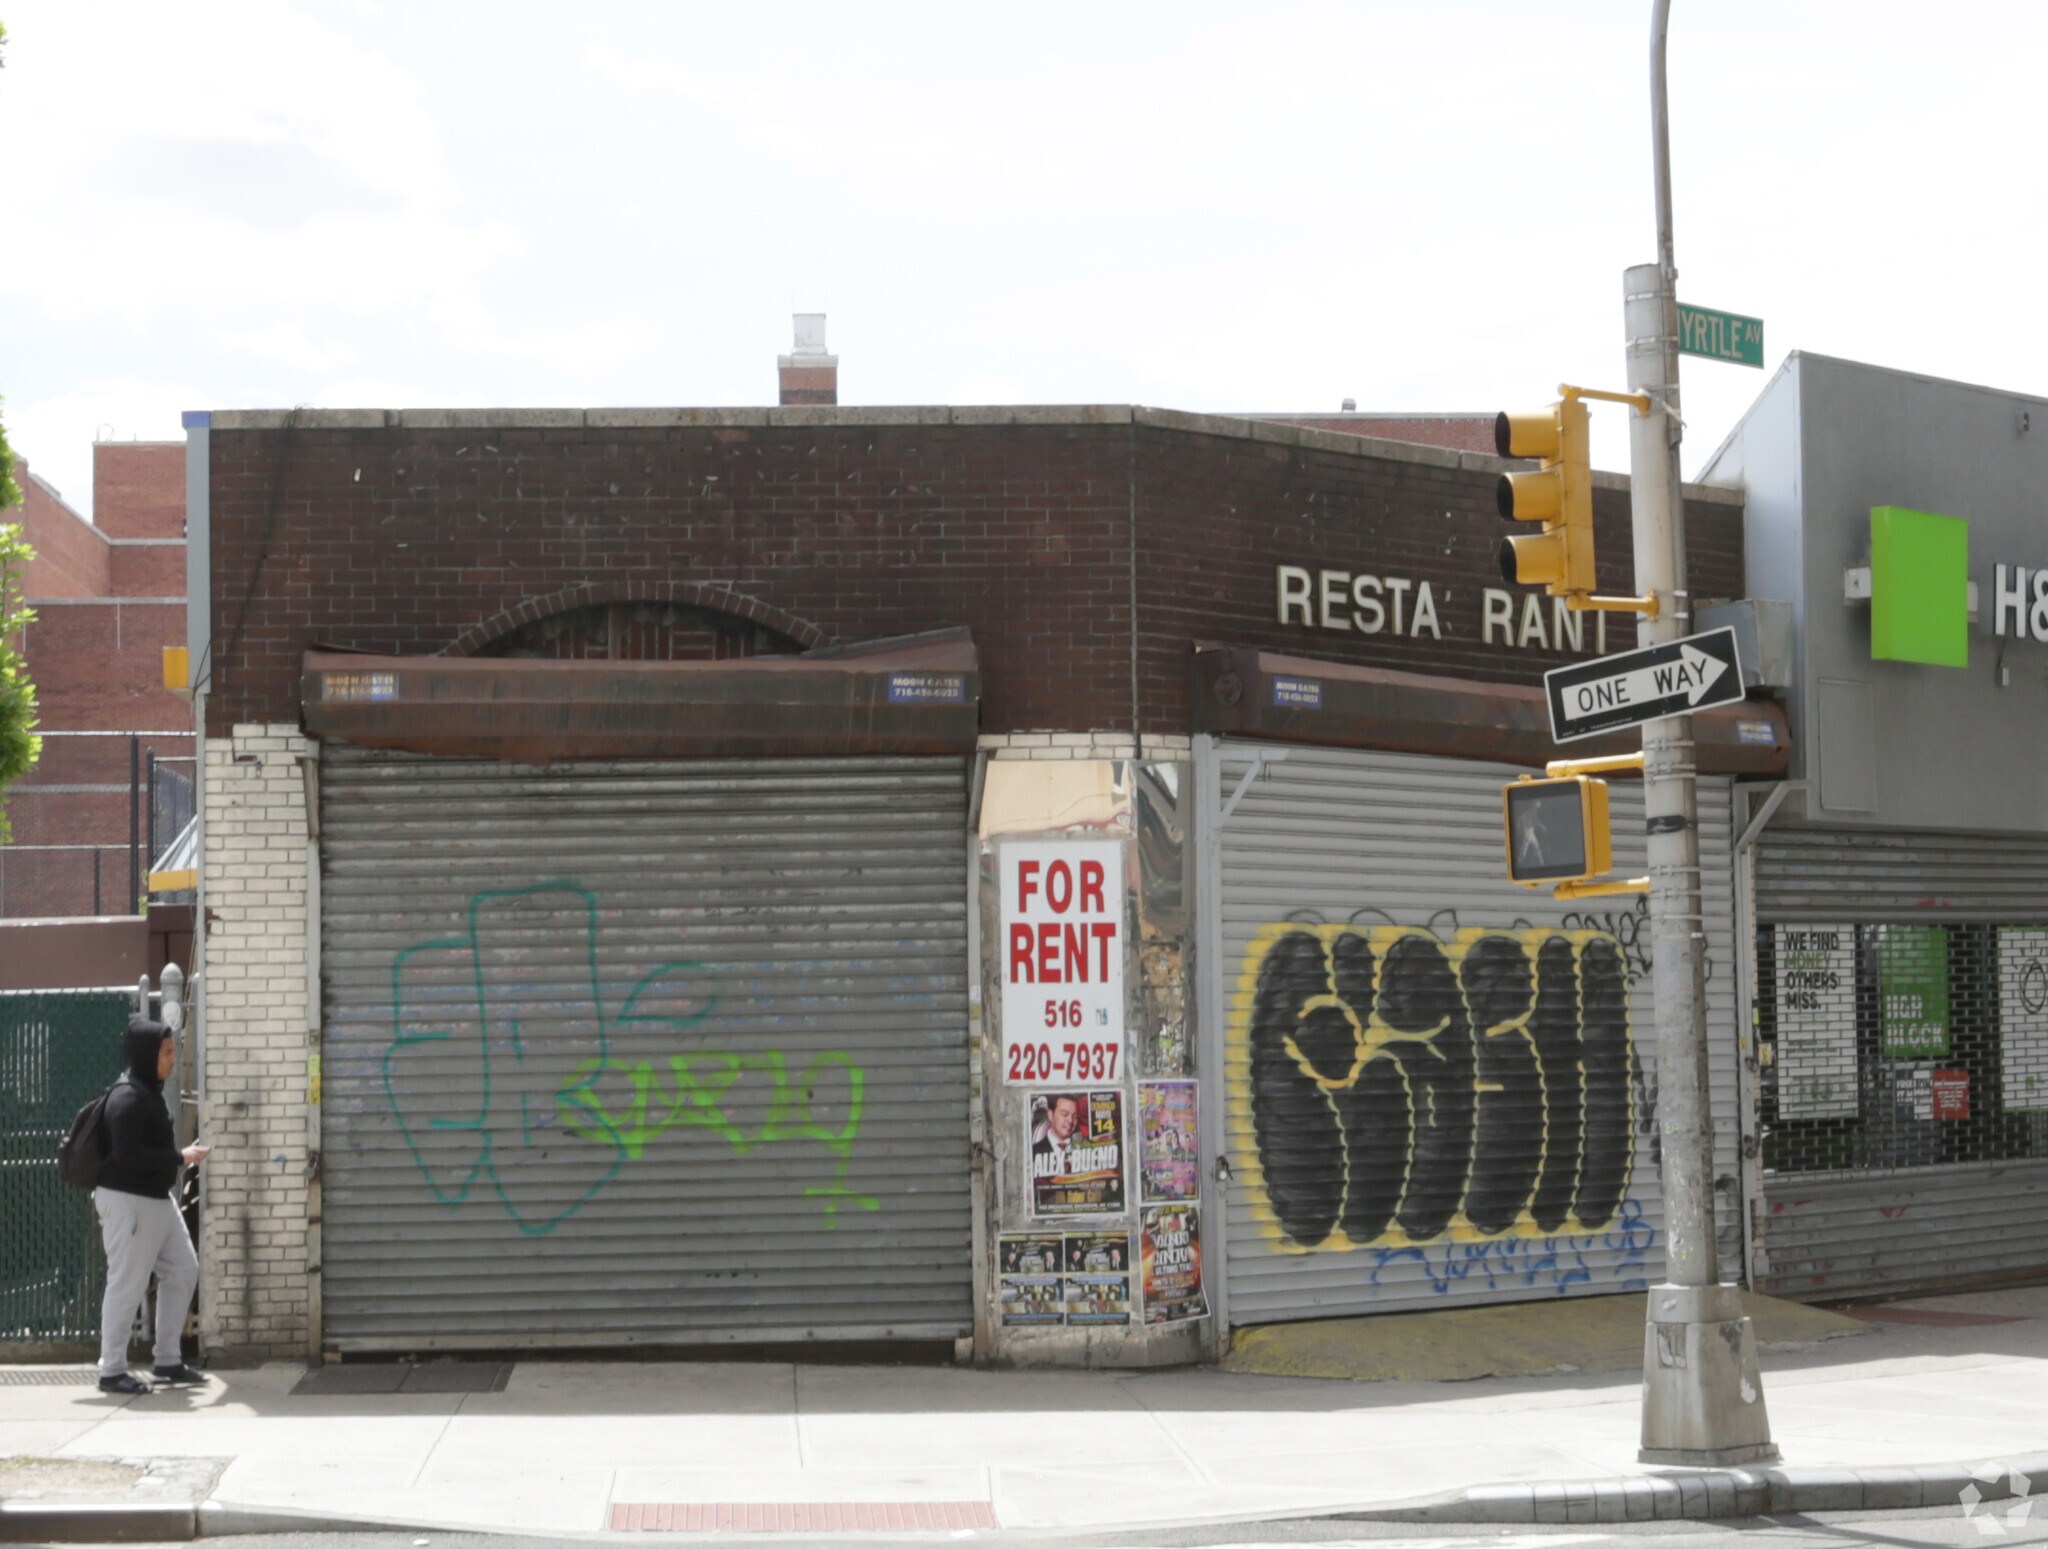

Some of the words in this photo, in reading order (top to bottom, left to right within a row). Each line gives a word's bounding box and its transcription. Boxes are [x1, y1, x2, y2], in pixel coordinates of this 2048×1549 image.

[1677, 309, 1743, 358] YRTLE
[1744, 323, 1762, 344] AV
[1276, 565, 1441, 640] RESTA
[1578, 678, 1631, 713] ONE
[1654, 658, 1708, 695] WAY
[1018, 859, 1105, 914] FOR
[1010, 923, 1116, 984] RENT
[1785, 931, 1807, 950] WE
[1811, 931, 1840, 950] FIND
[1785, 951, 1831, 969] MONEY
[1786, 971, 1838, 990] OTHERS
[1045, 1000, 1082, 1028] 516
[1008, 1042, 1119, 1080] 220-7937
[1094, 1119, 1115, 1133] 14
[1034, 1150, 1066, 1178] ALEX
[1071, 1144, 1119, 1173] BUENO
